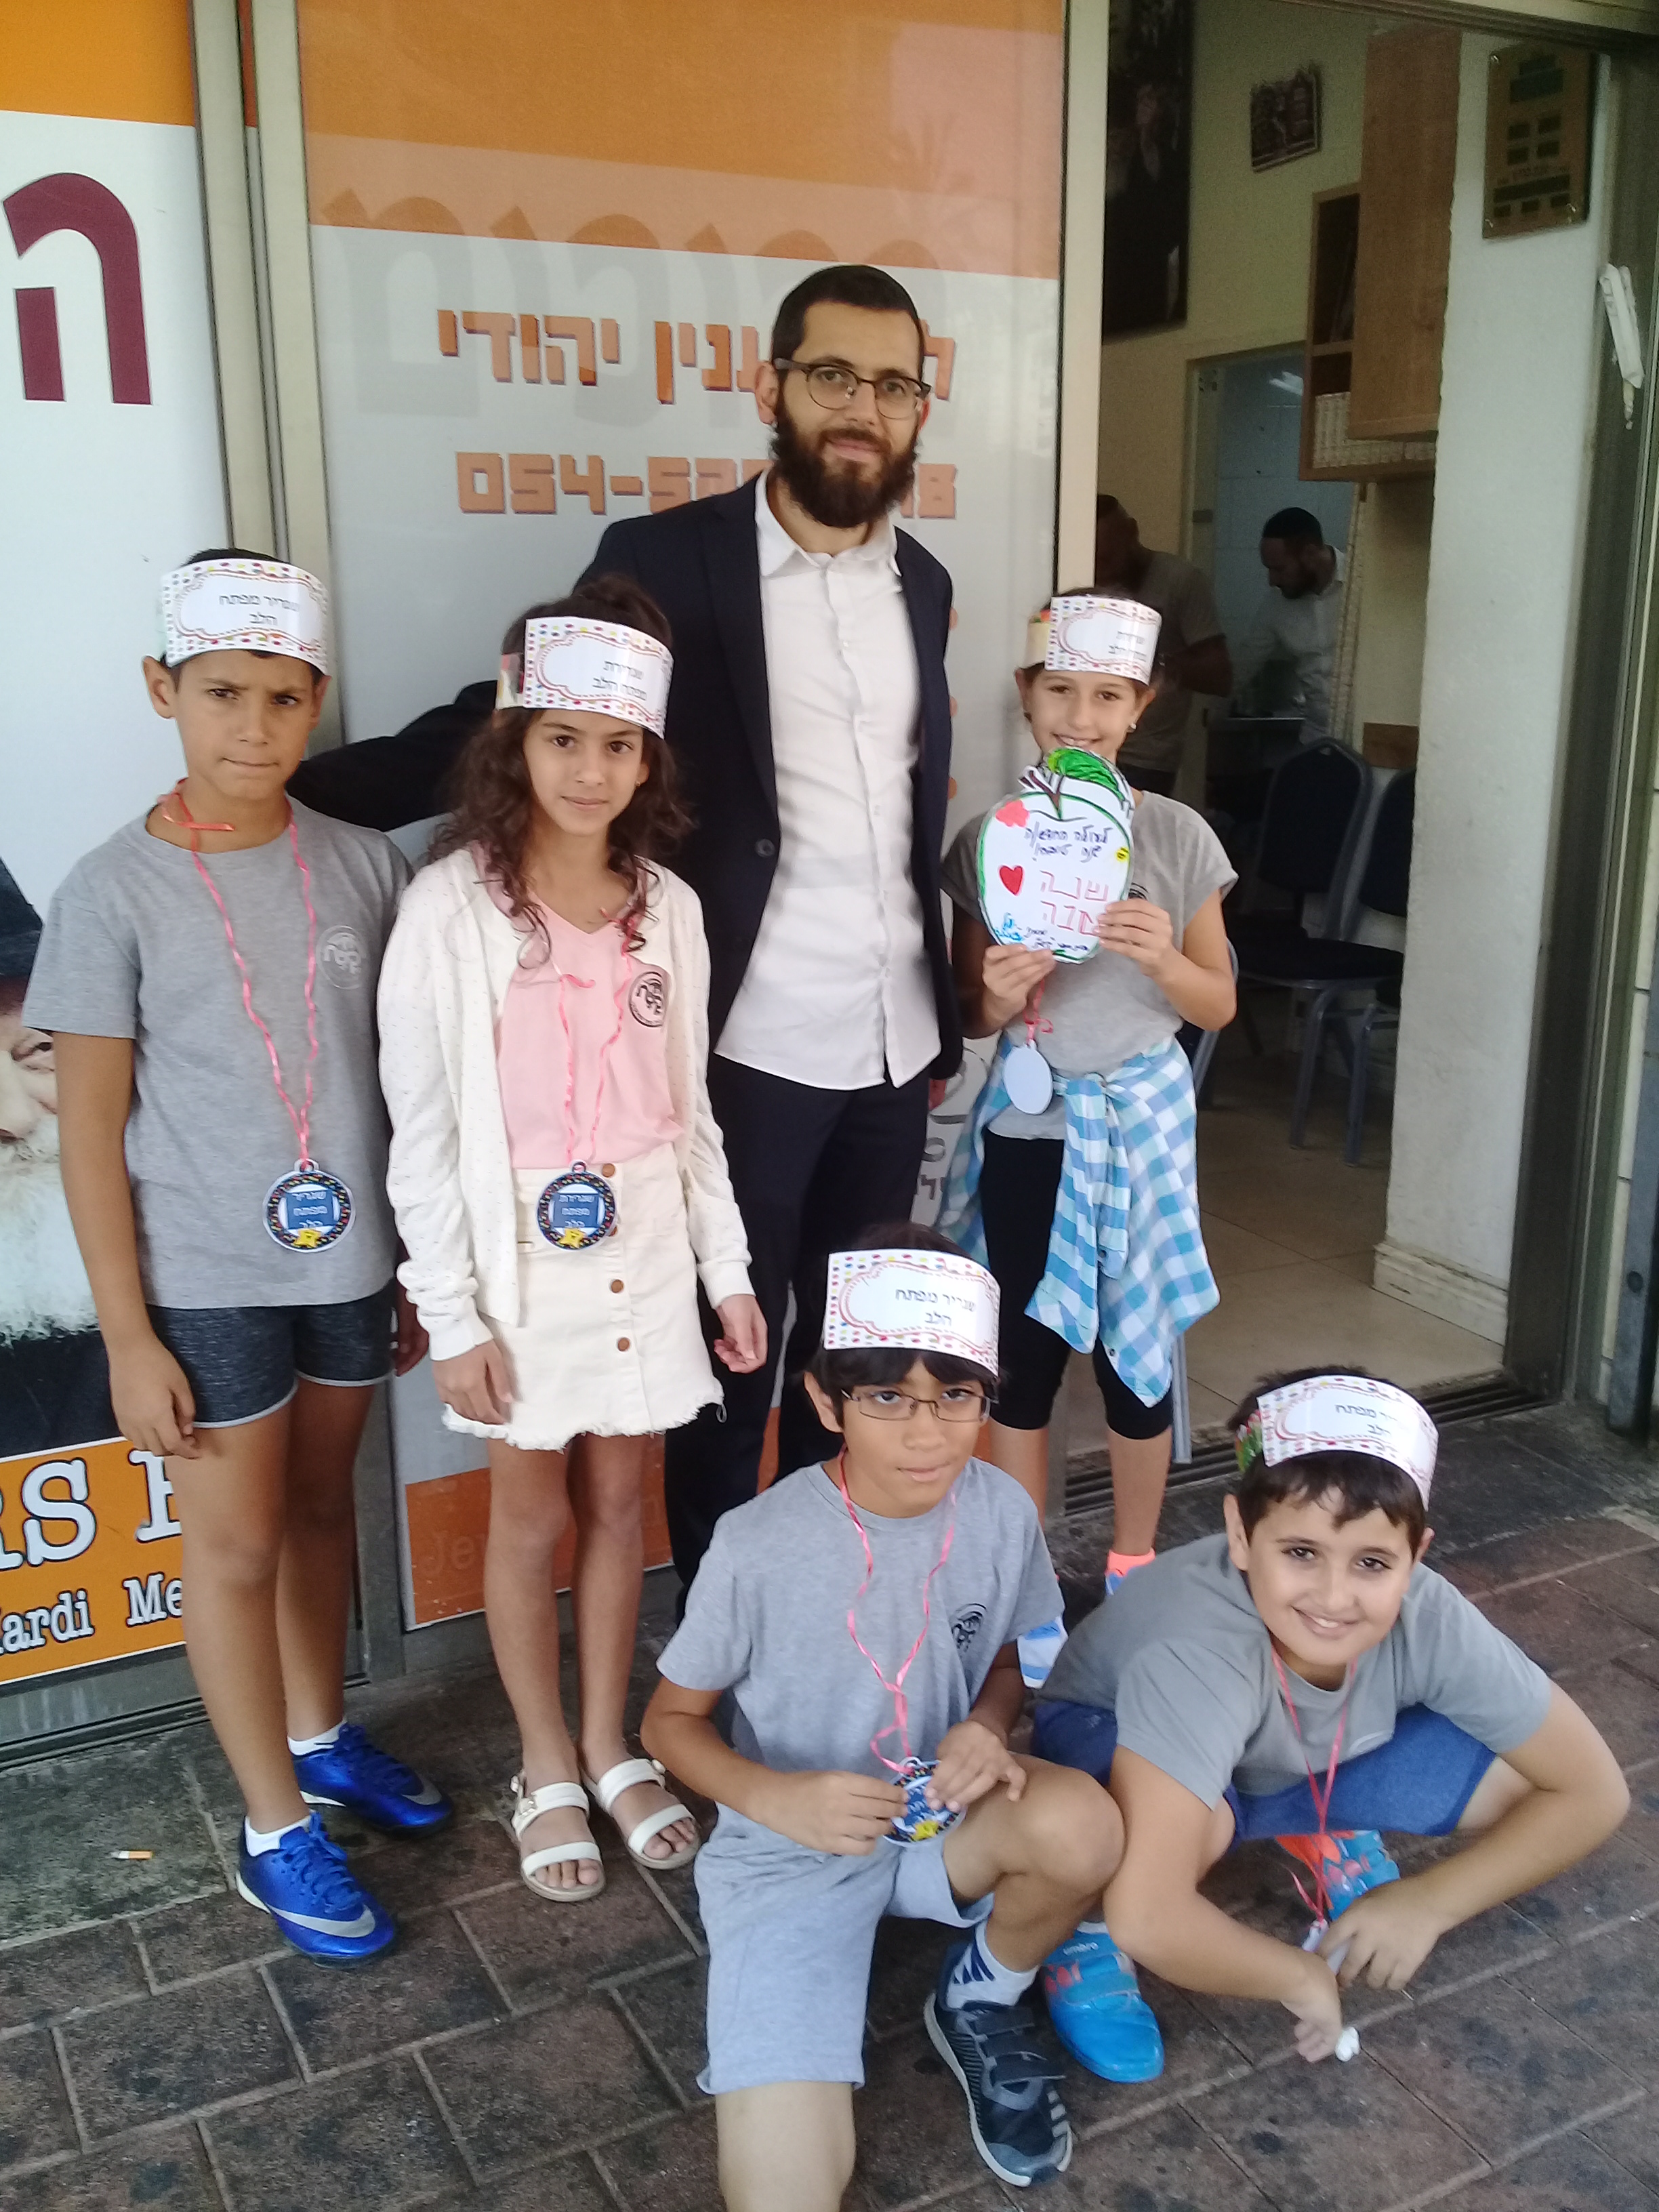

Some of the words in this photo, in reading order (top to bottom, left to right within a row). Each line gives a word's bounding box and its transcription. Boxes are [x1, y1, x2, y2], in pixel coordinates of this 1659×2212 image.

[438, 310, 621, 386] יהודי
[219, 594, 262, 606] מפתח
[249, 612, 278, 626] הלב
[592, 675, 618, 691] הלב
[1040, 869, 1109, 901] שנה
[895, 1288, 939, 1303] מפתח
[924, 1310, 953, 1326] הלב
[1334, 1404, 1377, 1419] מפתח
[0, 1588, 96, 1658] ardi
